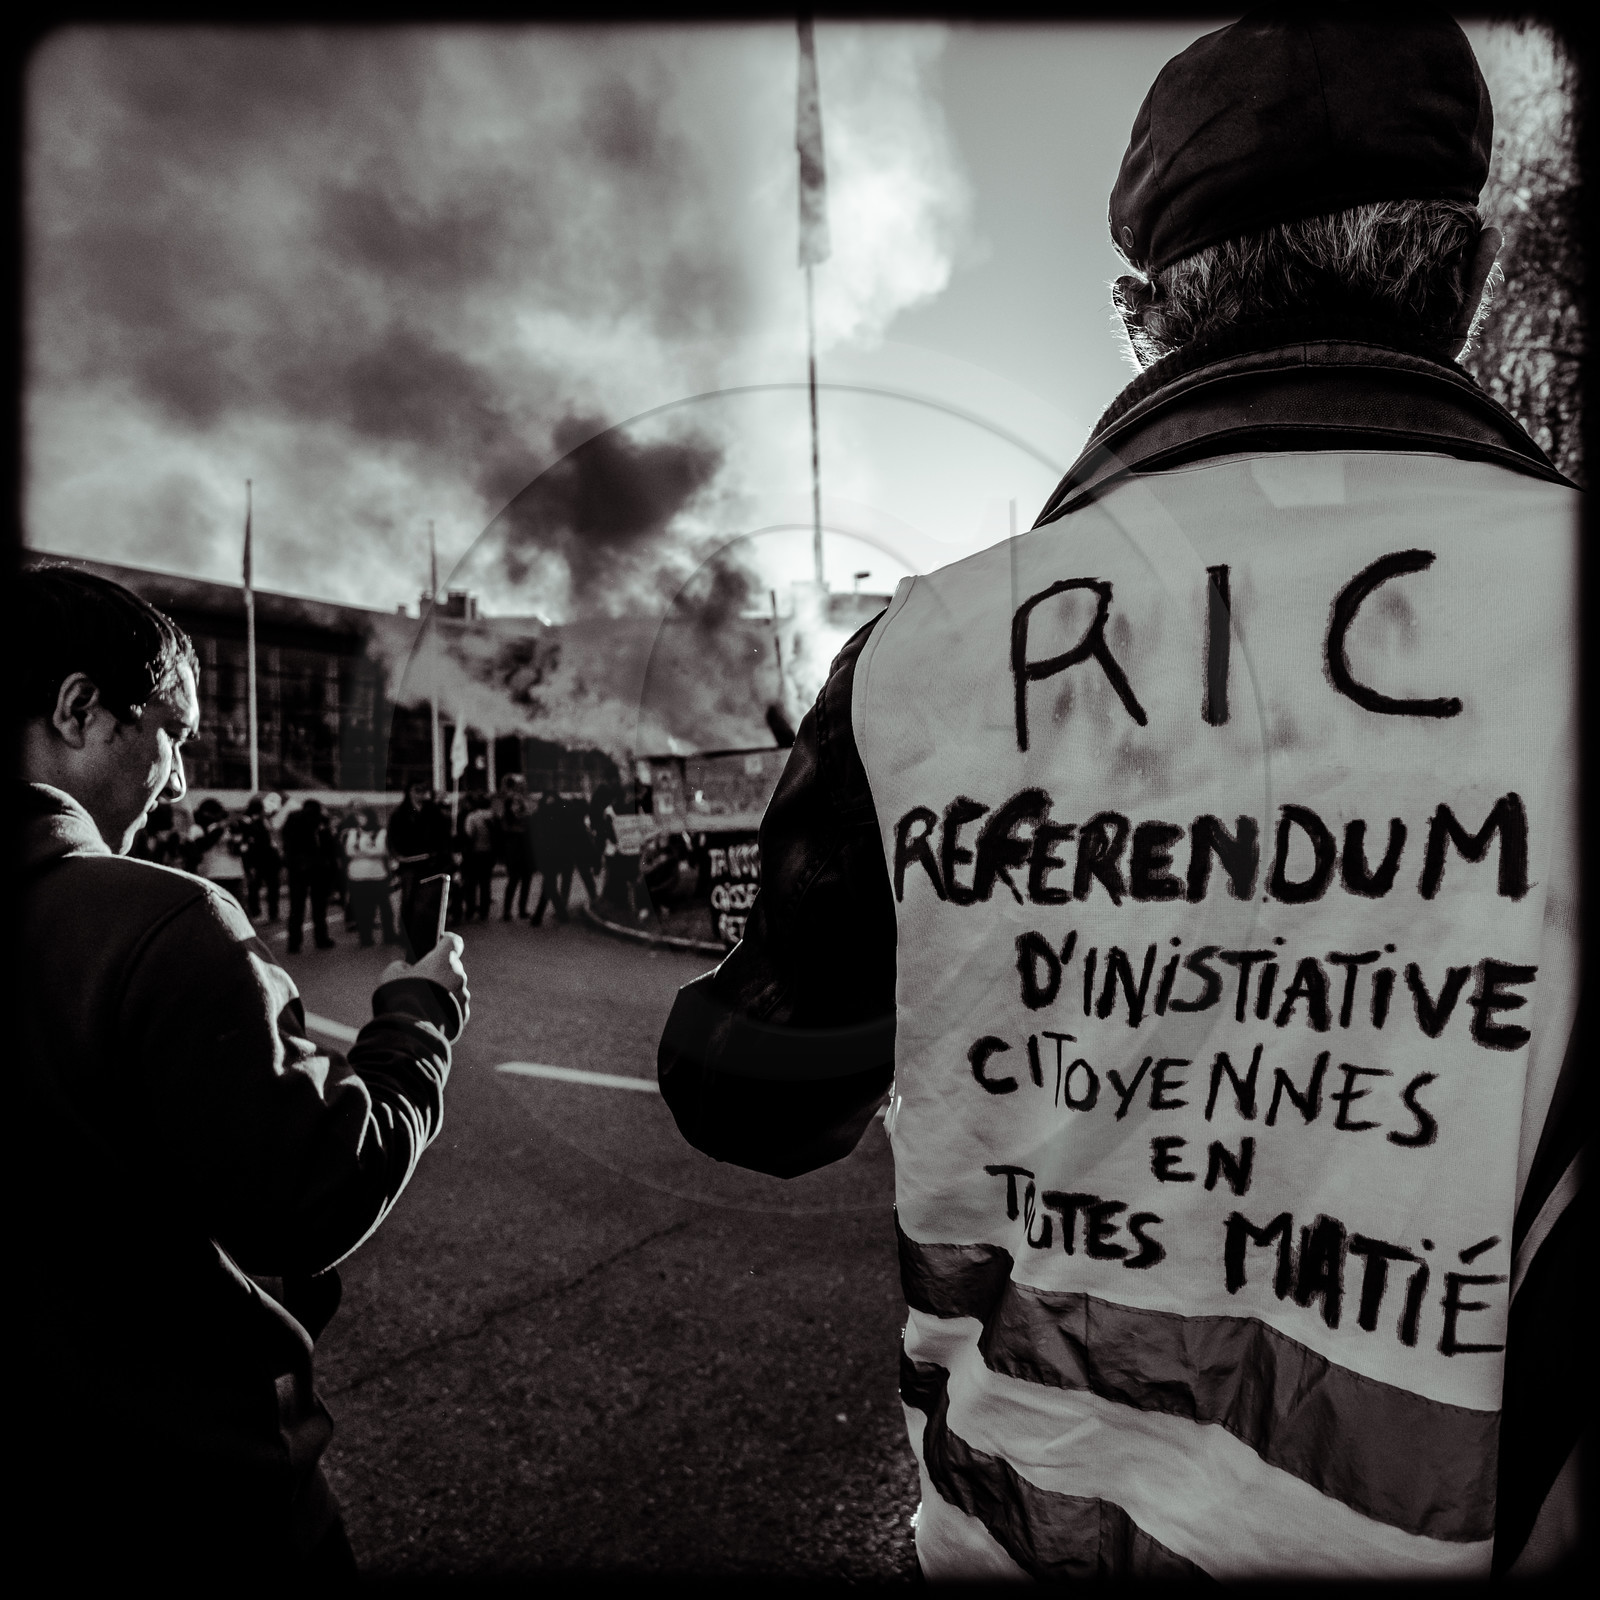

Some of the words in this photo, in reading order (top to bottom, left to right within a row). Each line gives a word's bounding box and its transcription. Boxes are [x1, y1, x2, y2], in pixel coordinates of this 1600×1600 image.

[1010, 548, 1464, 753] RIC
[893, 786, 1530, 906] REFERENDUM
[966, 1031, 1440, 1149] CITOYENNES
[1149, 1136, 1257, 1197] EN
